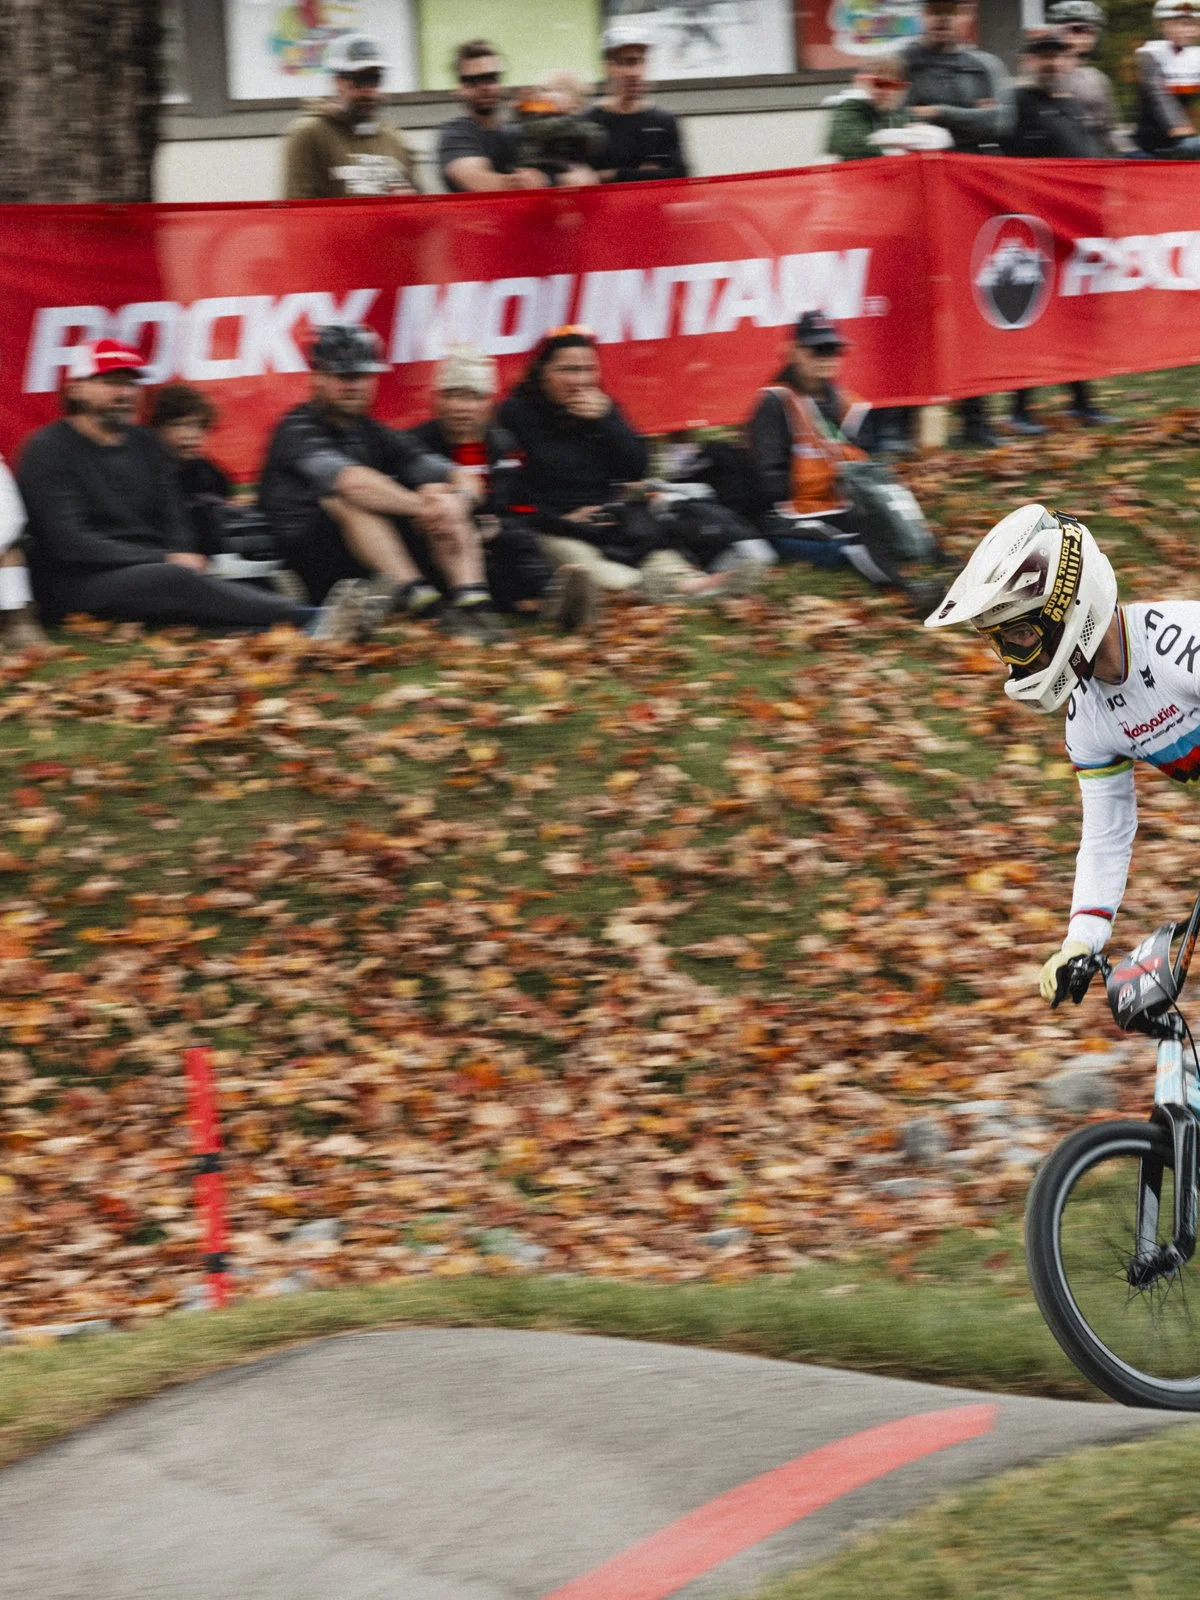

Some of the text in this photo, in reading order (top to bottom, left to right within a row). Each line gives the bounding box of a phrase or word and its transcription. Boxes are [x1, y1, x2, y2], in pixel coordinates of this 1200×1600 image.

[23, 247, 872, 394] ROCKY MOUNTAIN
[1043, 538, 1071, 616] SUPER TRICK
